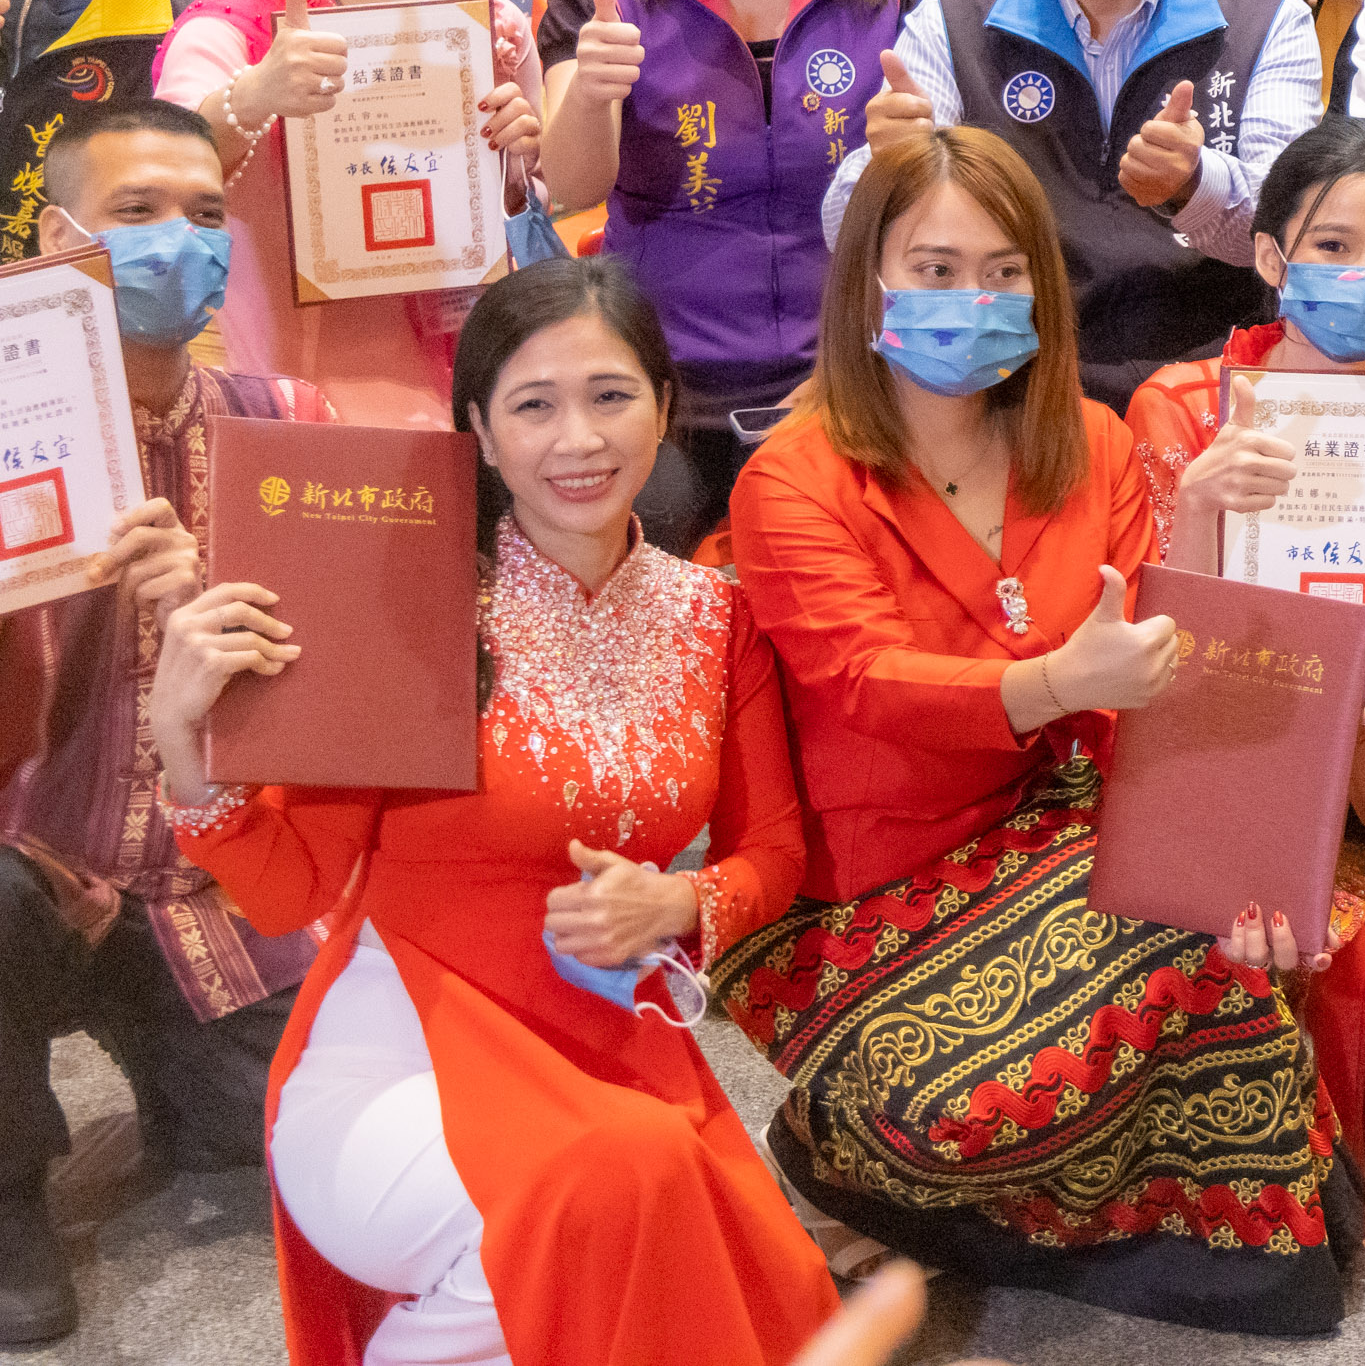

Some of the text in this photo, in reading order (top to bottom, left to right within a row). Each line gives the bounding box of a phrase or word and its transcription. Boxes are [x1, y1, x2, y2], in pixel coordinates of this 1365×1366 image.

[352, 64, 424, 85] 結業證書
[1207, 70, 1237, 155] 新北市
[300, 481, 435, 514] 新北市政府
[302, 511, 437, 526] New Taipei City Government
[1202, 636, 1325, 683] 新北市政府
